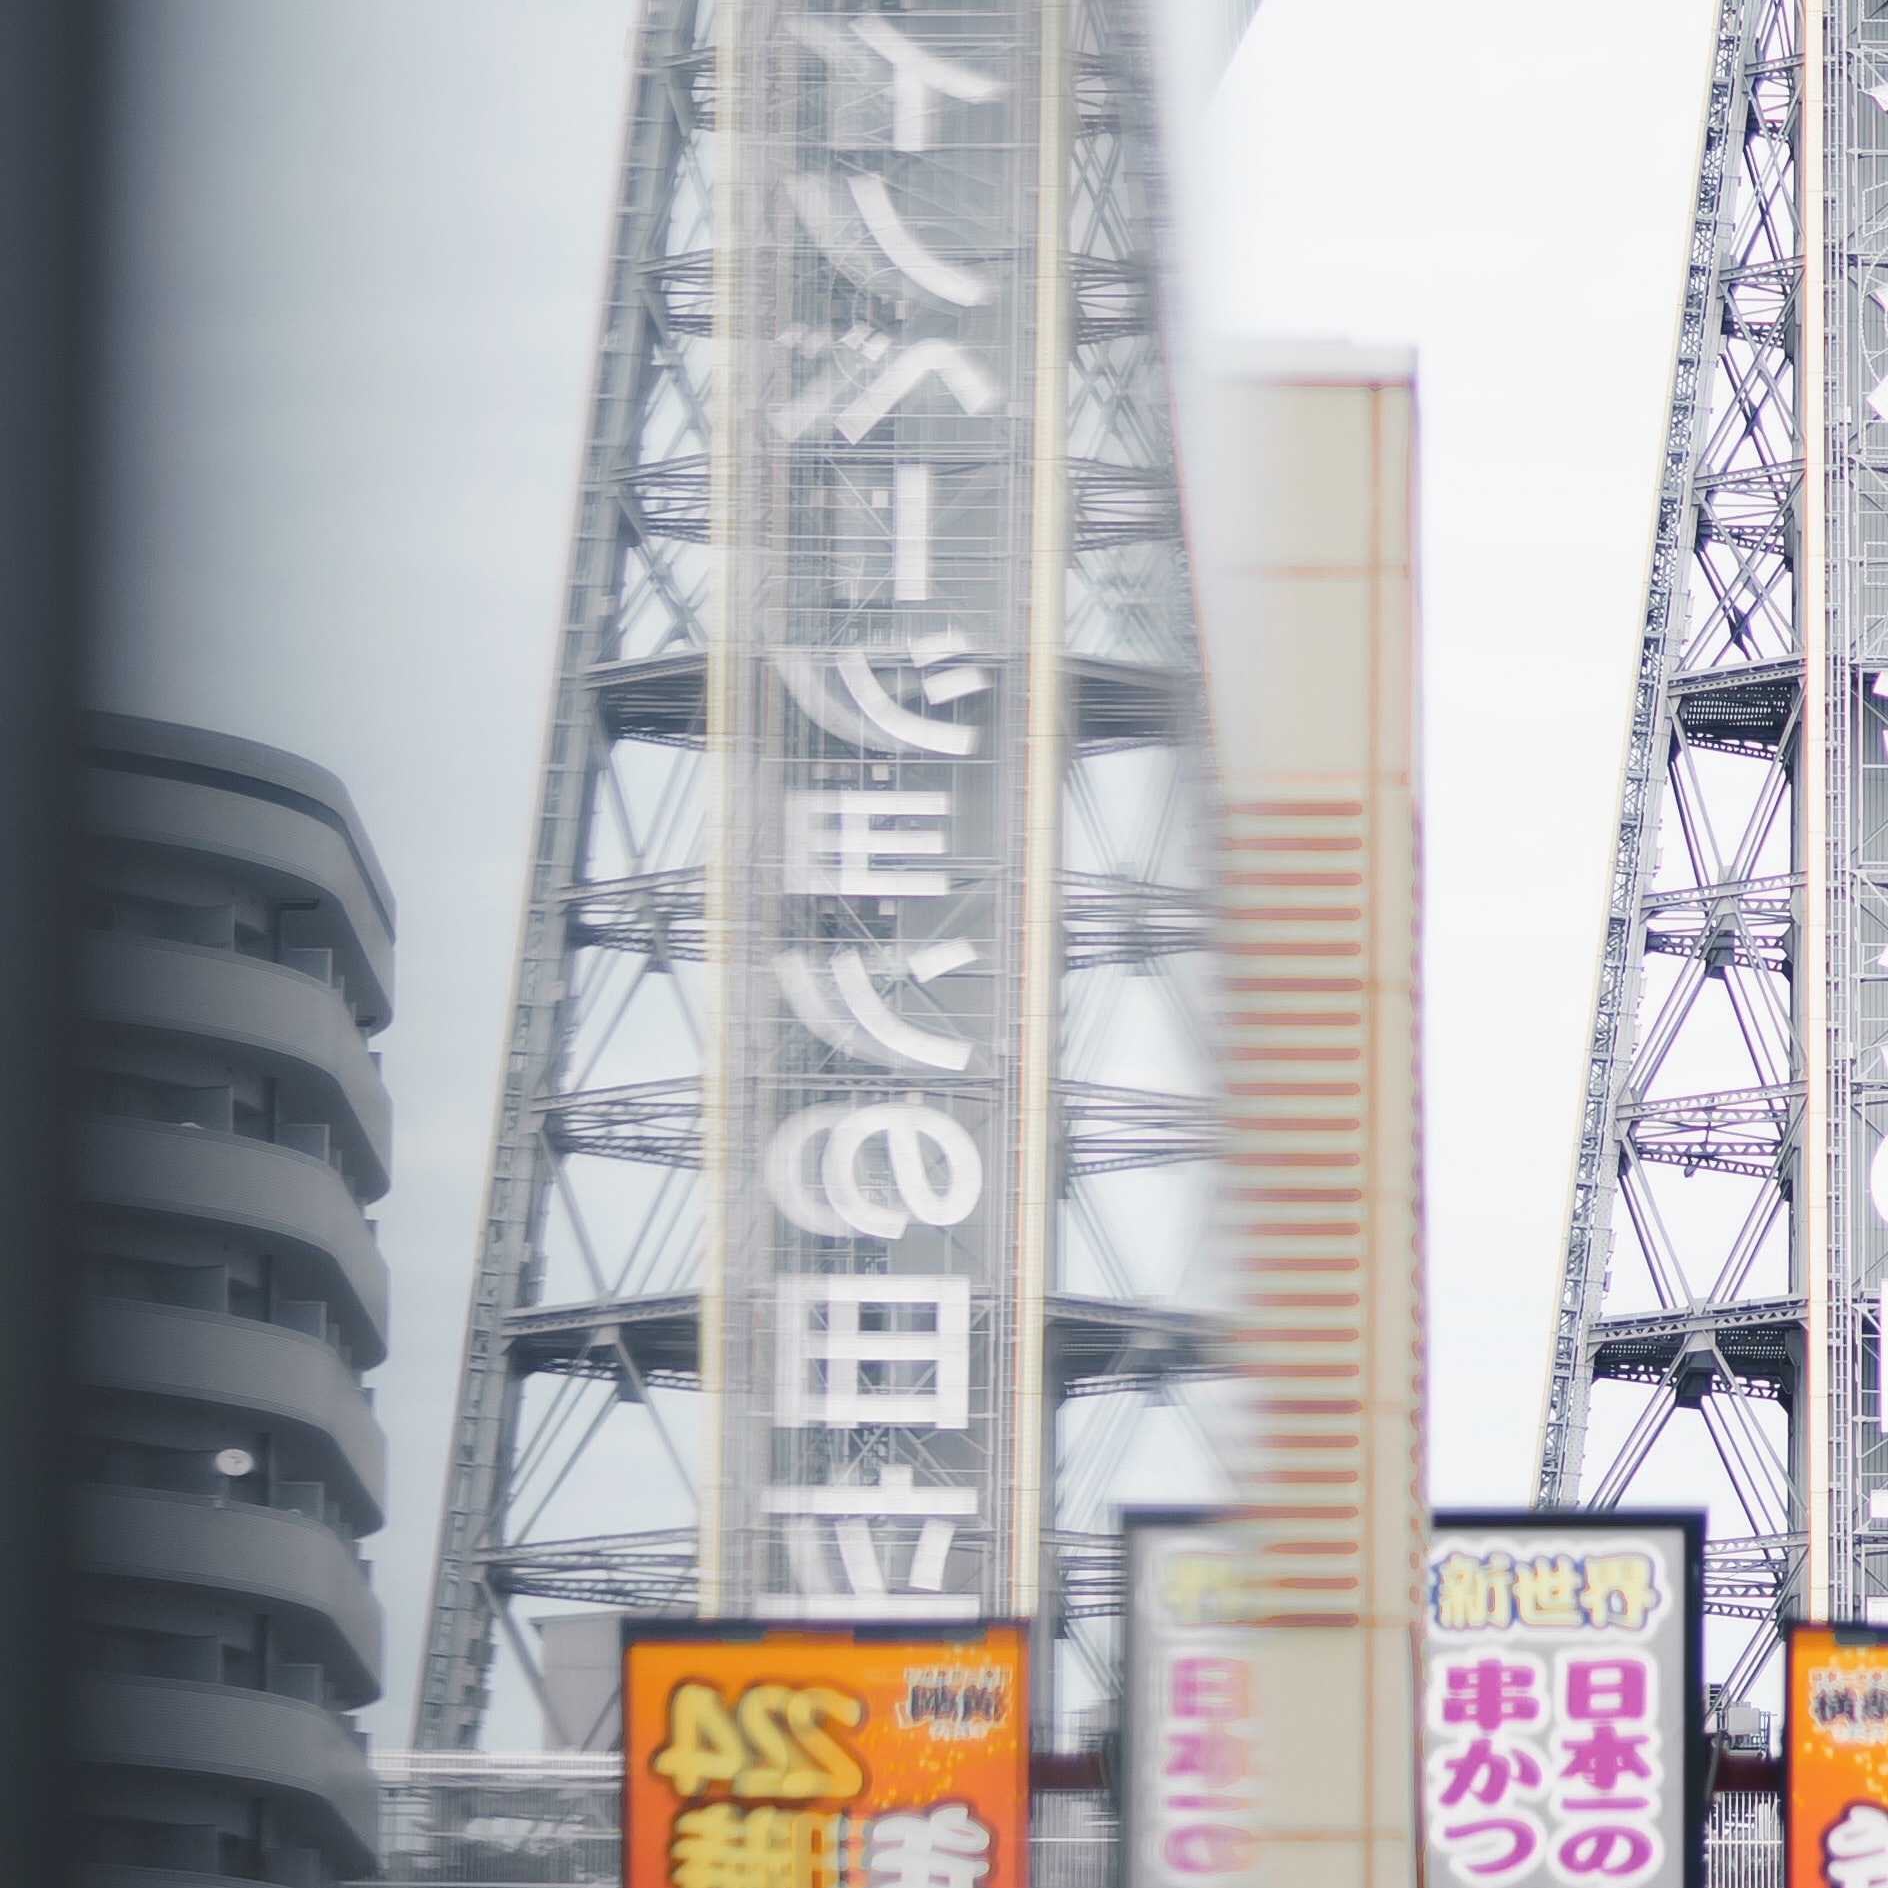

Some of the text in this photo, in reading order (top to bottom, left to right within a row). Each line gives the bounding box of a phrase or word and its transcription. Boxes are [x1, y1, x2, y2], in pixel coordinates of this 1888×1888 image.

[1434, 1555, 1660, 1628] 新世界
[1441, 1660, 1540, 1875] 串かつ
[1559, 1660, 1653, 1875] 日本一の
